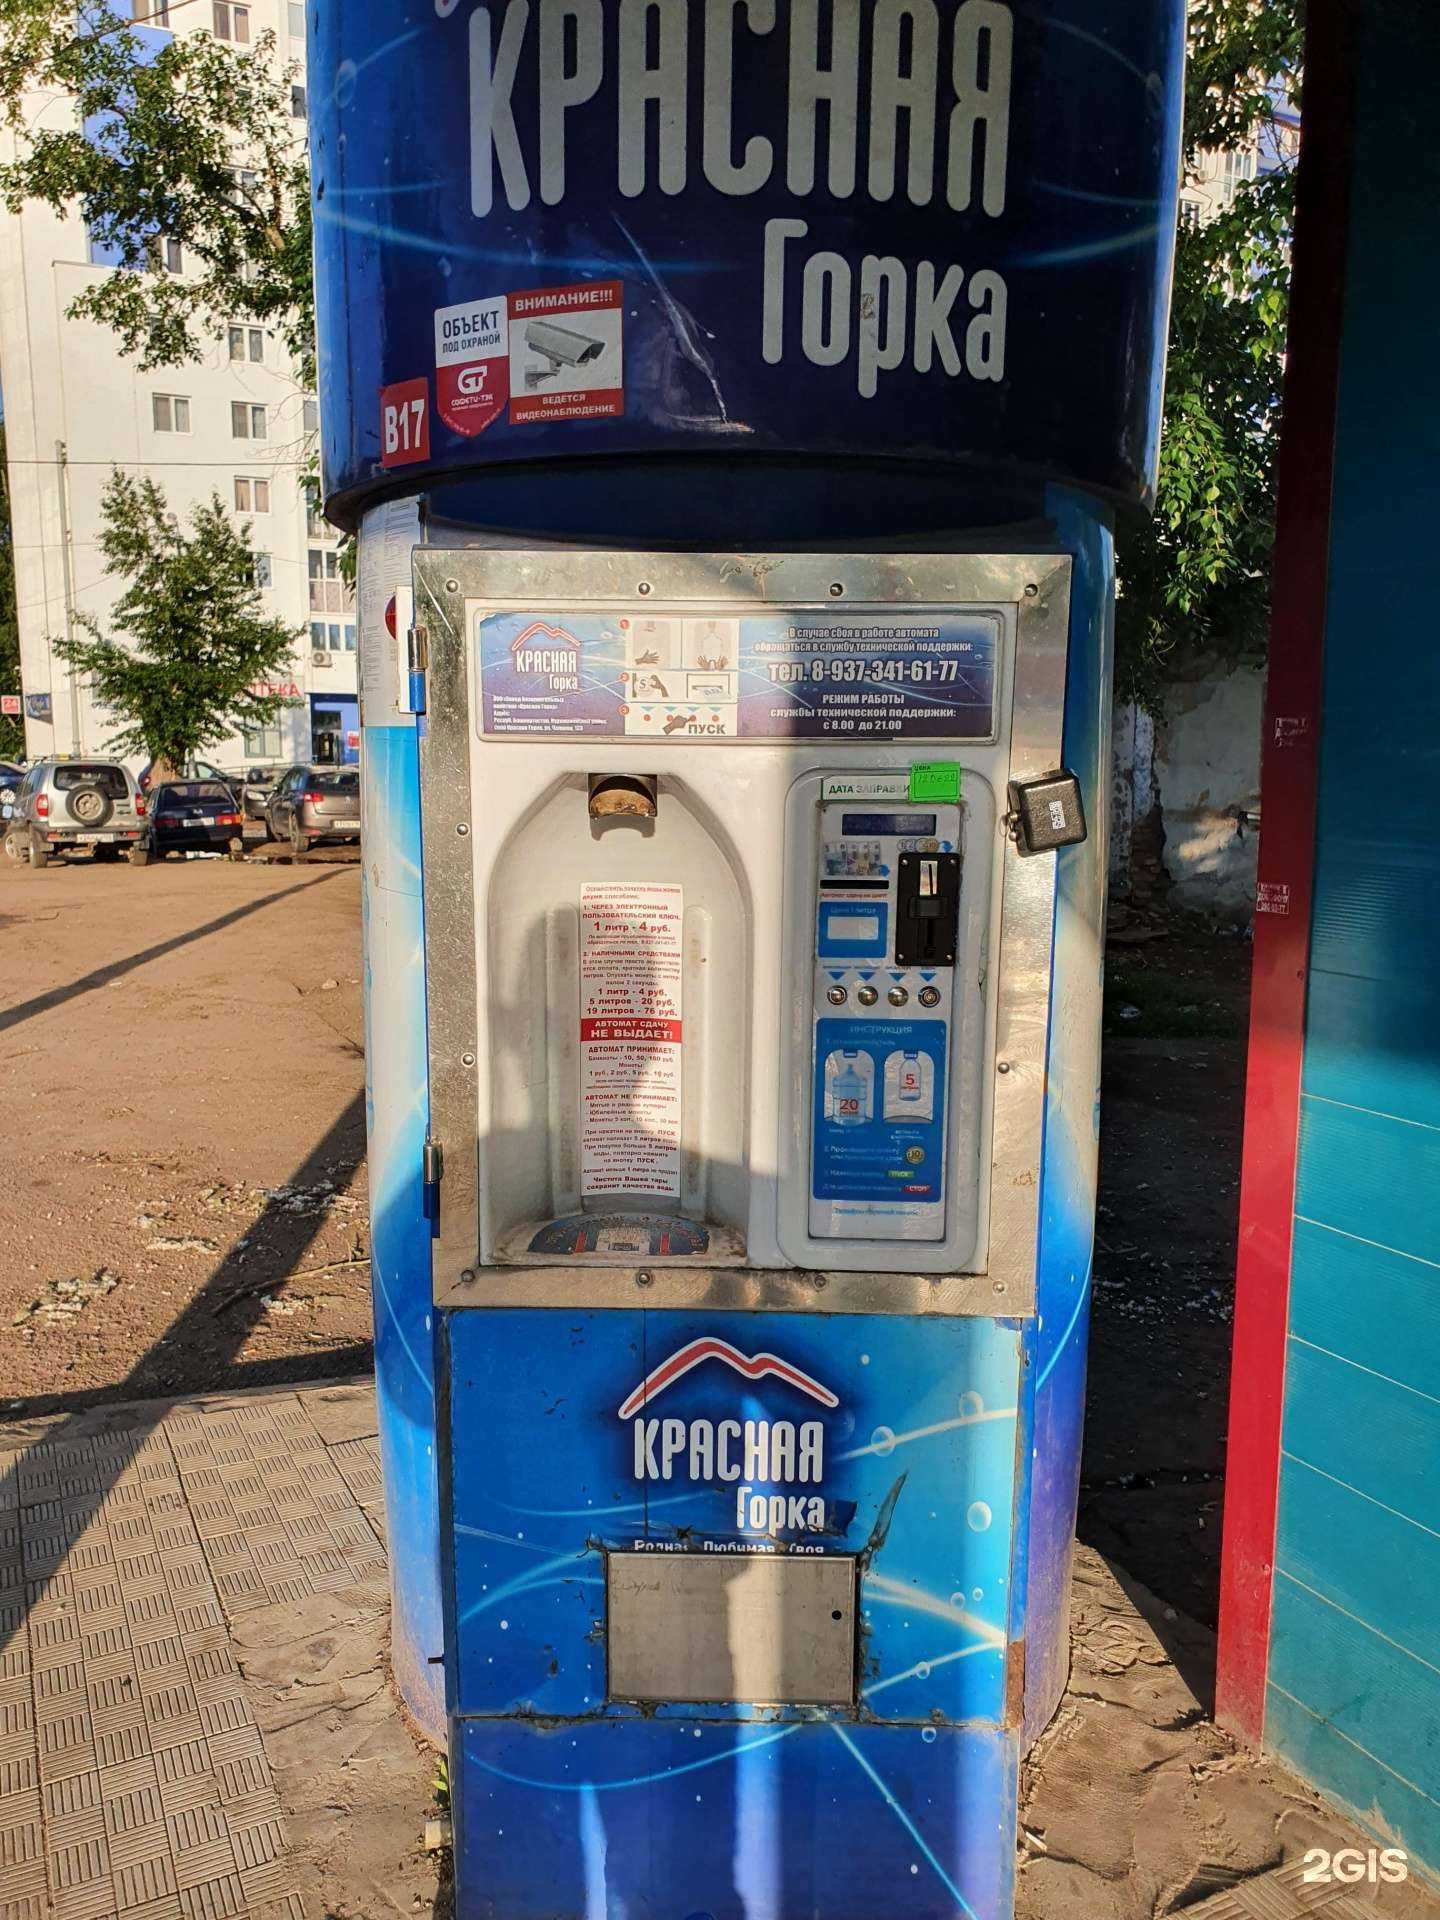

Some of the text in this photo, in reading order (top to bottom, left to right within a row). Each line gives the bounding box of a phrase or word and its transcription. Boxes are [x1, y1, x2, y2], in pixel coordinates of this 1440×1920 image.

[469, 0, 1014, 218] КРАСНАЯ
[515, 289, 613, 311] ВНИМАНИЕ!!!
[762, 218, 1006, 399] Горка
[442, 310, 500, 339] ОБЪЕКТ
[442, 332, 501, 354] ПОД ОХРАНОЙ
[542, 394, 586, 405] ВЕДЕТСЯ
[516, 405, 615, 421] ВИДЕОНАБЛЮДЕНИЕ
[790, 627, 940, 639] В случае сбоя в работе автомата
[755, 641, 973, 652] обращаться в службу технической поддержки:
[516, 650, 577, 673] КРАСНАЯ
[769, 660, 958, 682] тел. 8-937-341-61-77
[549, 673, 578, 692] Горка
[823, 694, 904, 704] РЕЖИМ РАБОТЫ
[770, 707, 956, 718] службы технической поддержки:
[688, 723, 726, 735] ПУСК
[823, 720, 902, 731] с 8.00 до 21.00
[828, 784, 910, 794] ДАТА ЗАПРАВИ
[594, 921, 672, 933] 1 литр 4 руб.
[598, 999, 632, 1007] литров
[590, 1030, 673, 1040] НЕ ВЫДАЕТ!
[906, 1074, 916, 1086] 5
[840, 1098, 859, 1111] 20
[634, 1418, 824, 1483] КРАСНАЯ
[736, 1486, 825, 1536] Горка
